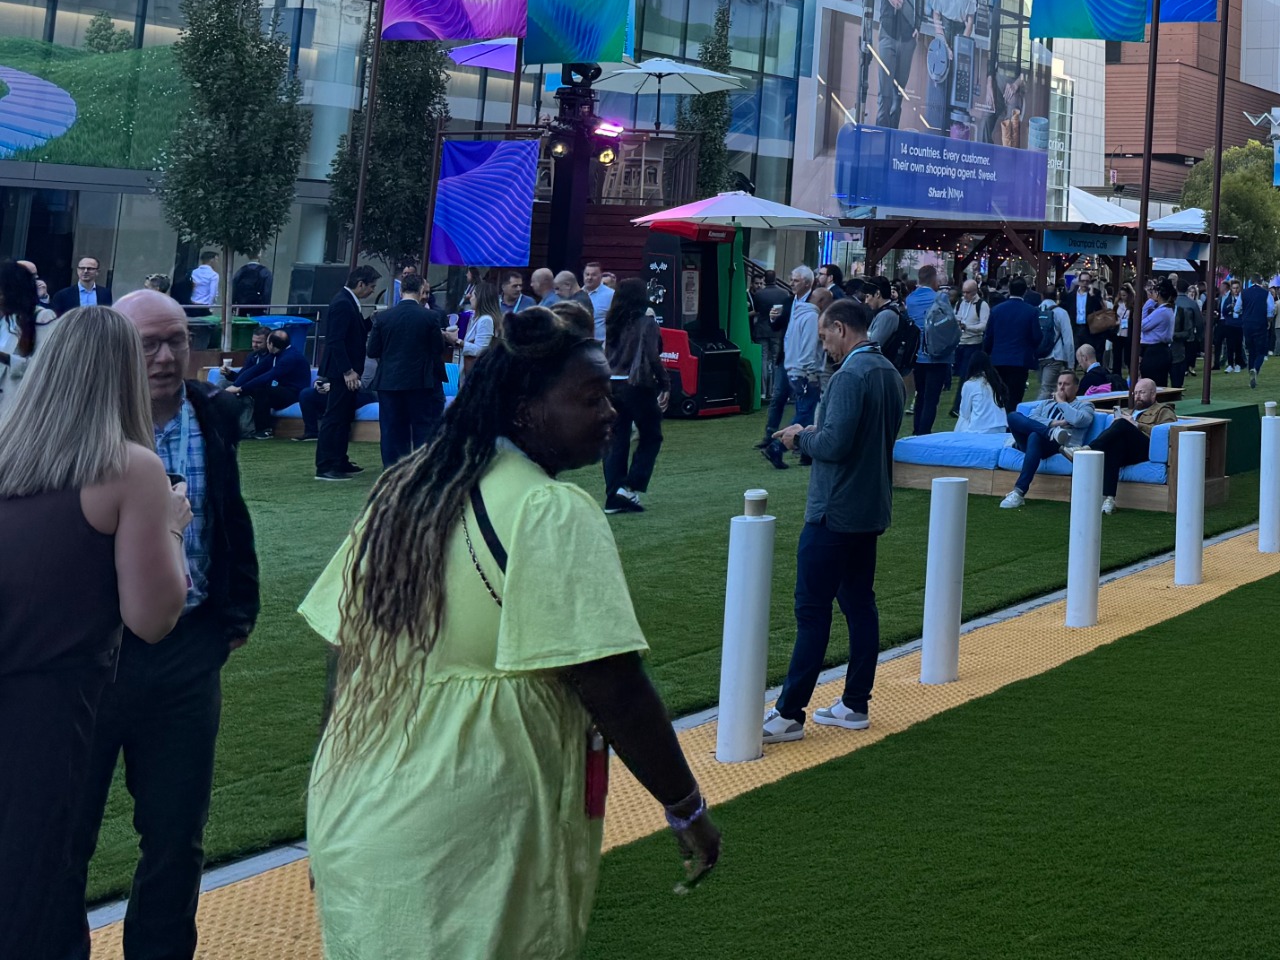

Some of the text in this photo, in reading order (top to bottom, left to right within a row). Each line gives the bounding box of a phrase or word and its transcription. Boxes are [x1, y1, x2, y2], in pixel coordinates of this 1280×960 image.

[900, 142, 991, 166] 14 countries. Every customer.
[892, 158, 997, 181] Their own shopping agent. Sweet.
[928, 186, 947, 198] Shark
